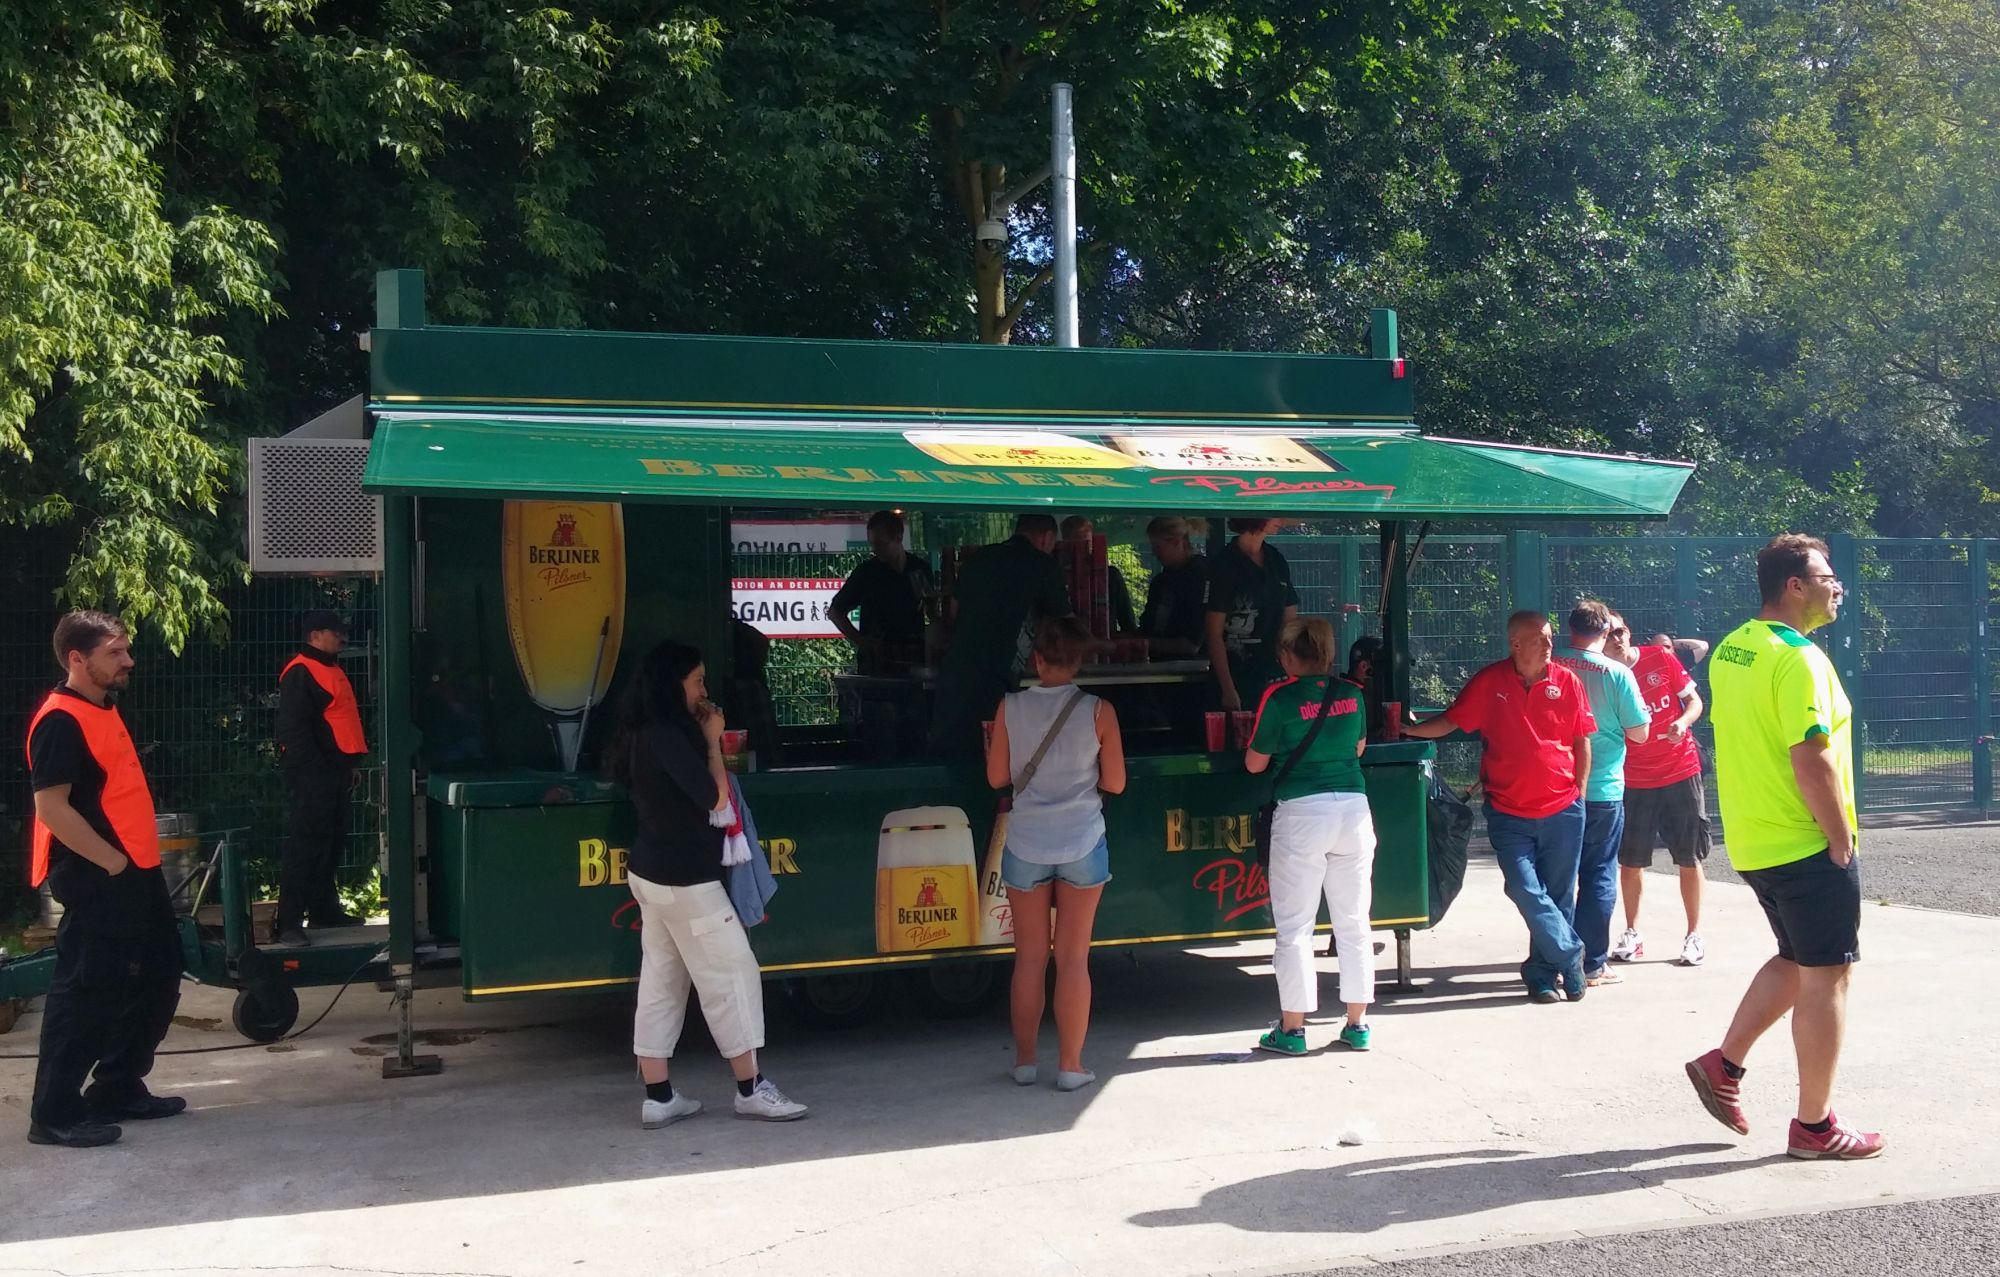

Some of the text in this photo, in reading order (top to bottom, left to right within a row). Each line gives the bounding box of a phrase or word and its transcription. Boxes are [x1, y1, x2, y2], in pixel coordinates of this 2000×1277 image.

[638, 458, 1396, 501] BERLINER Pilsner
[529, 545, 600, 566] BERLINER
[538, 567, 592, 592] Pilsner
[769, 581, 784, 589] AN
[789, 581, 810, 589] DER
[731, 601, 805, 622] SGANG
[1165, 808, 1257, 853] BERL
[1191, 858, 1270, 921] Pils
[898, 907, 958, 925] BERLINER
[905, 926, 951, 948] Pilsner
